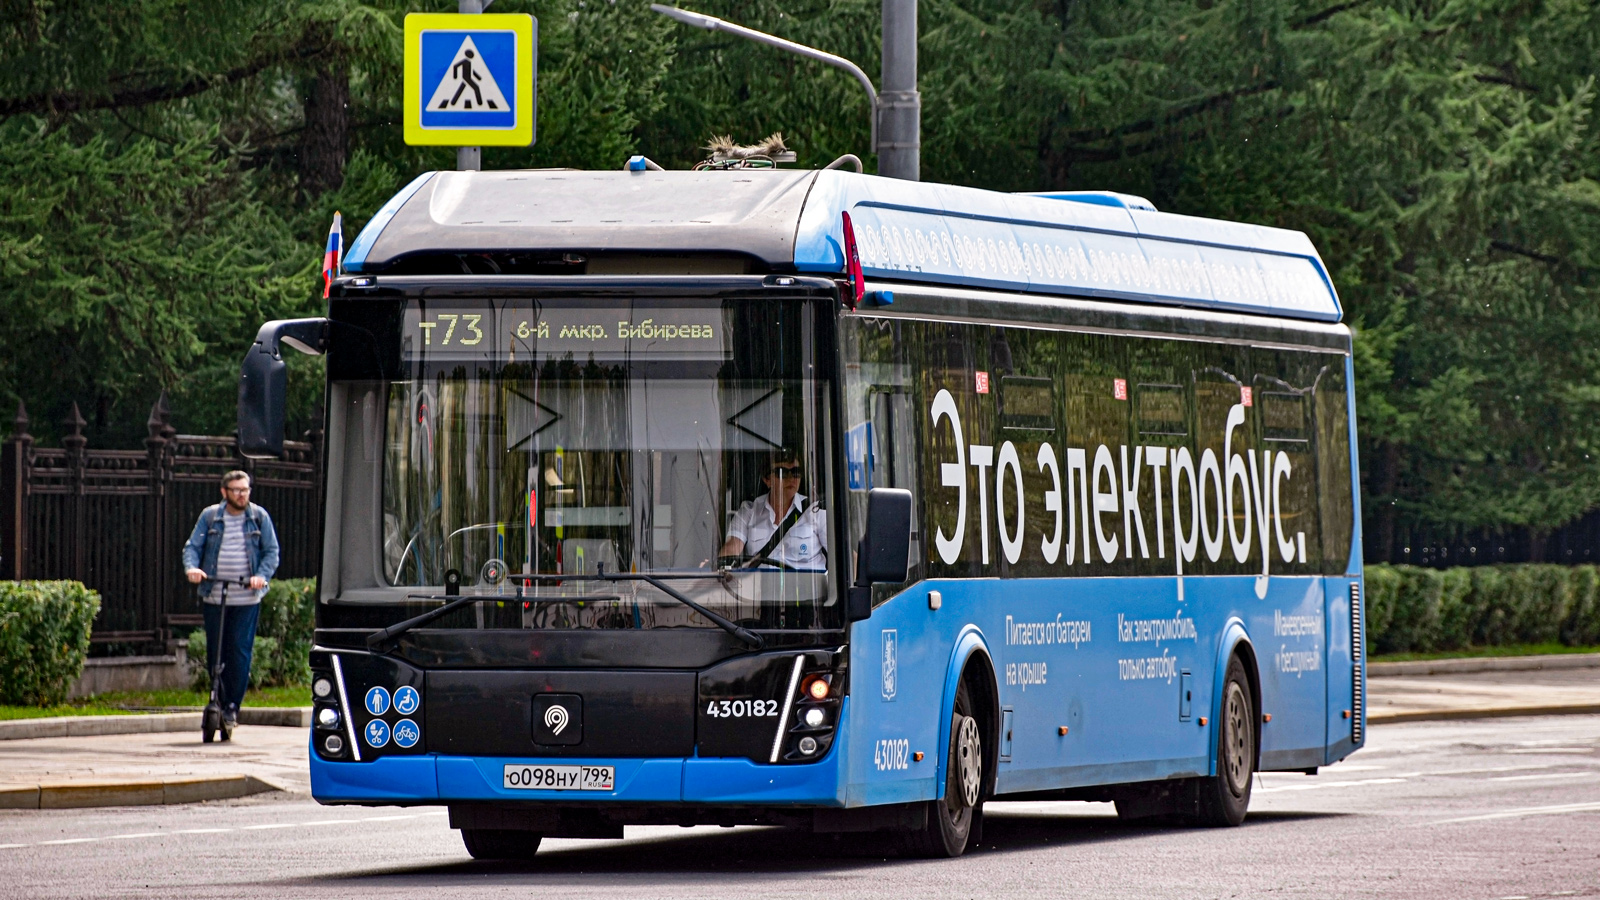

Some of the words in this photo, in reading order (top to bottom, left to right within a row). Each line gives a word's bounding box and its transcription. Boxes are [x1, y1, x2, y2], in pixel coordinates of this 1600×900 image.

[516, 319, 549, 339] 6-й
[559, 322, 608, 341] мкр.
[617, 318, 713, 341] Бибирева
[930, 388, 1026, 566] Это
[1036, 403, 1307, 602] электробус.
[1005, 614, 1046, 646] Питается
[1045, 621, 1056, 645] от
[1056, 612, 1091, 650] батареи
[1117, 612, 1134, 643] Как
[1134, 609, 1198, 648] электромобиль,
[1005, 662, 1017, 686] на
[1017, 661, 1047, 692] крыше
[1118, 658, 1146, 681] только
[1146, 647, 1177, 685] автобус
[706, 699, 778, 719] 430182
[874, 738, 909, 771] 430182
[582, 767, 609, 782] 799
